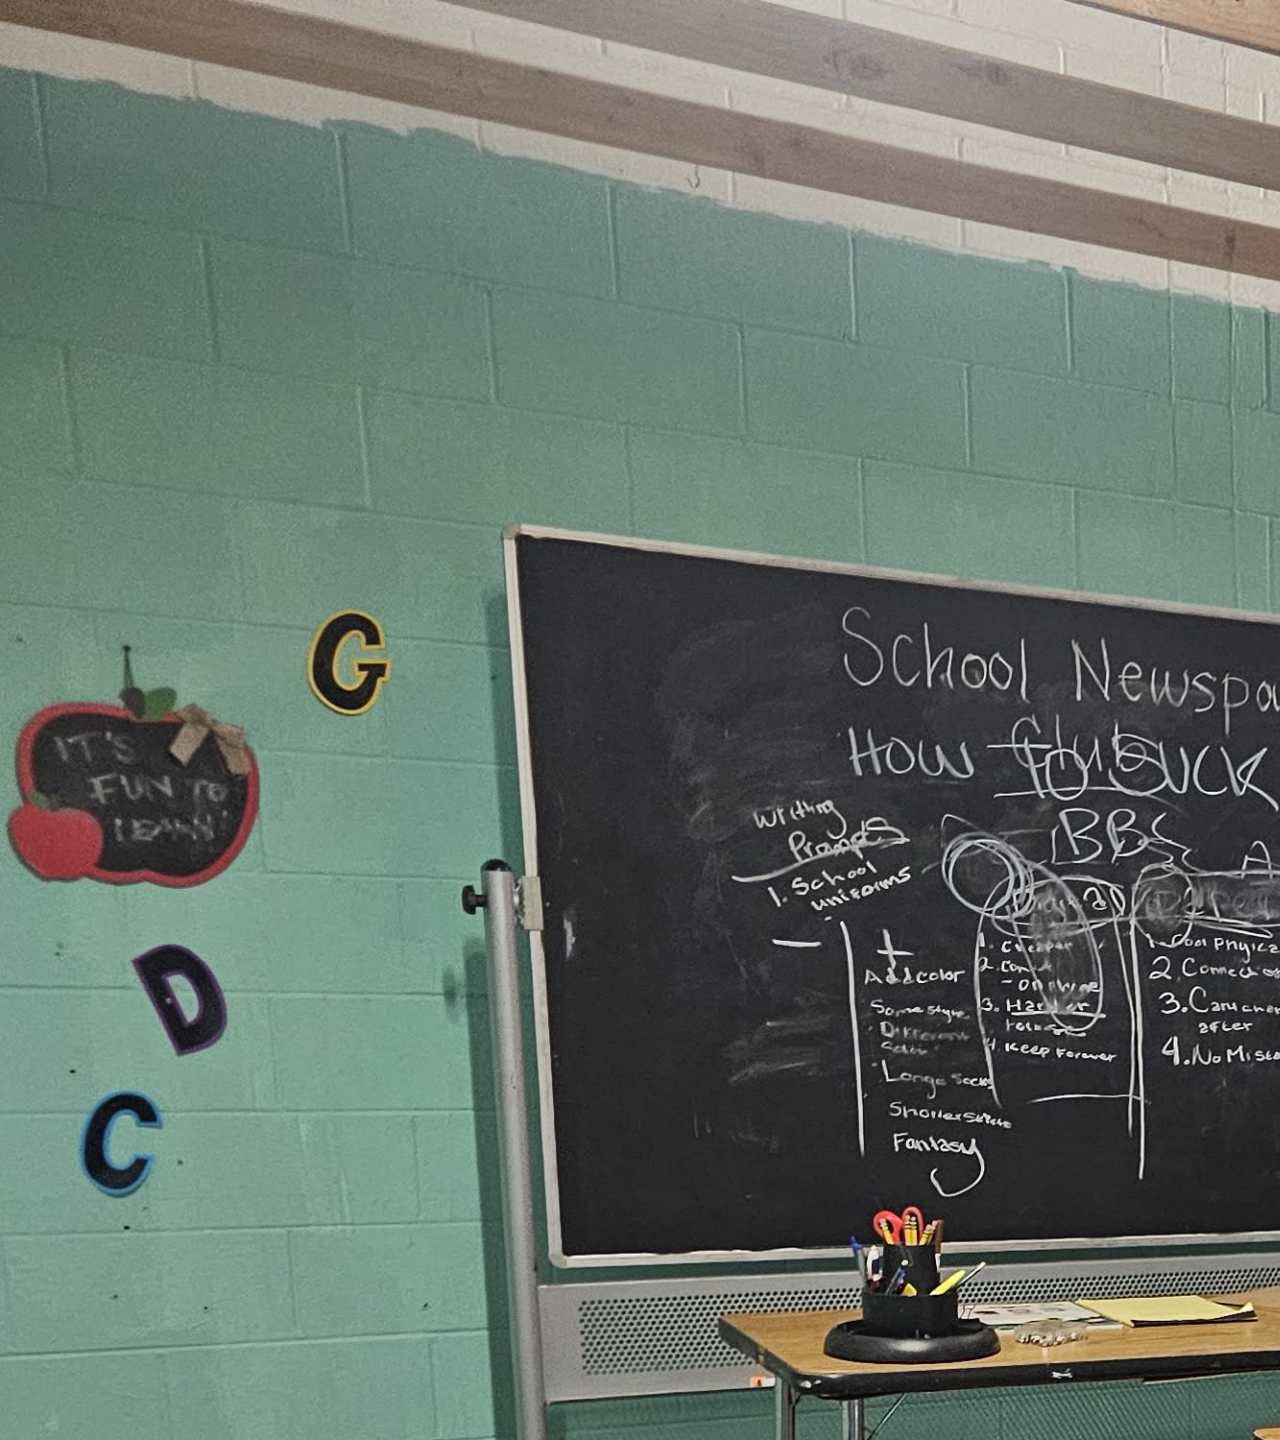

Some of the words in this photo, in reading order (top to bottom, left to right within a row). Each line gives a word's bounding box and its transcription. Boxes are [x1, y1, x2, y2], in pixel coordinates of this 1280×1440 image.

[307, 608, 392, 716] G
[841, 606, 1031, 703] School
[53, 731, 136, 764] IT'S
[88, 772, 174, 804] FUN
[131, 943, 228, 1057] D
[79, 1090, 164, 1198] C
